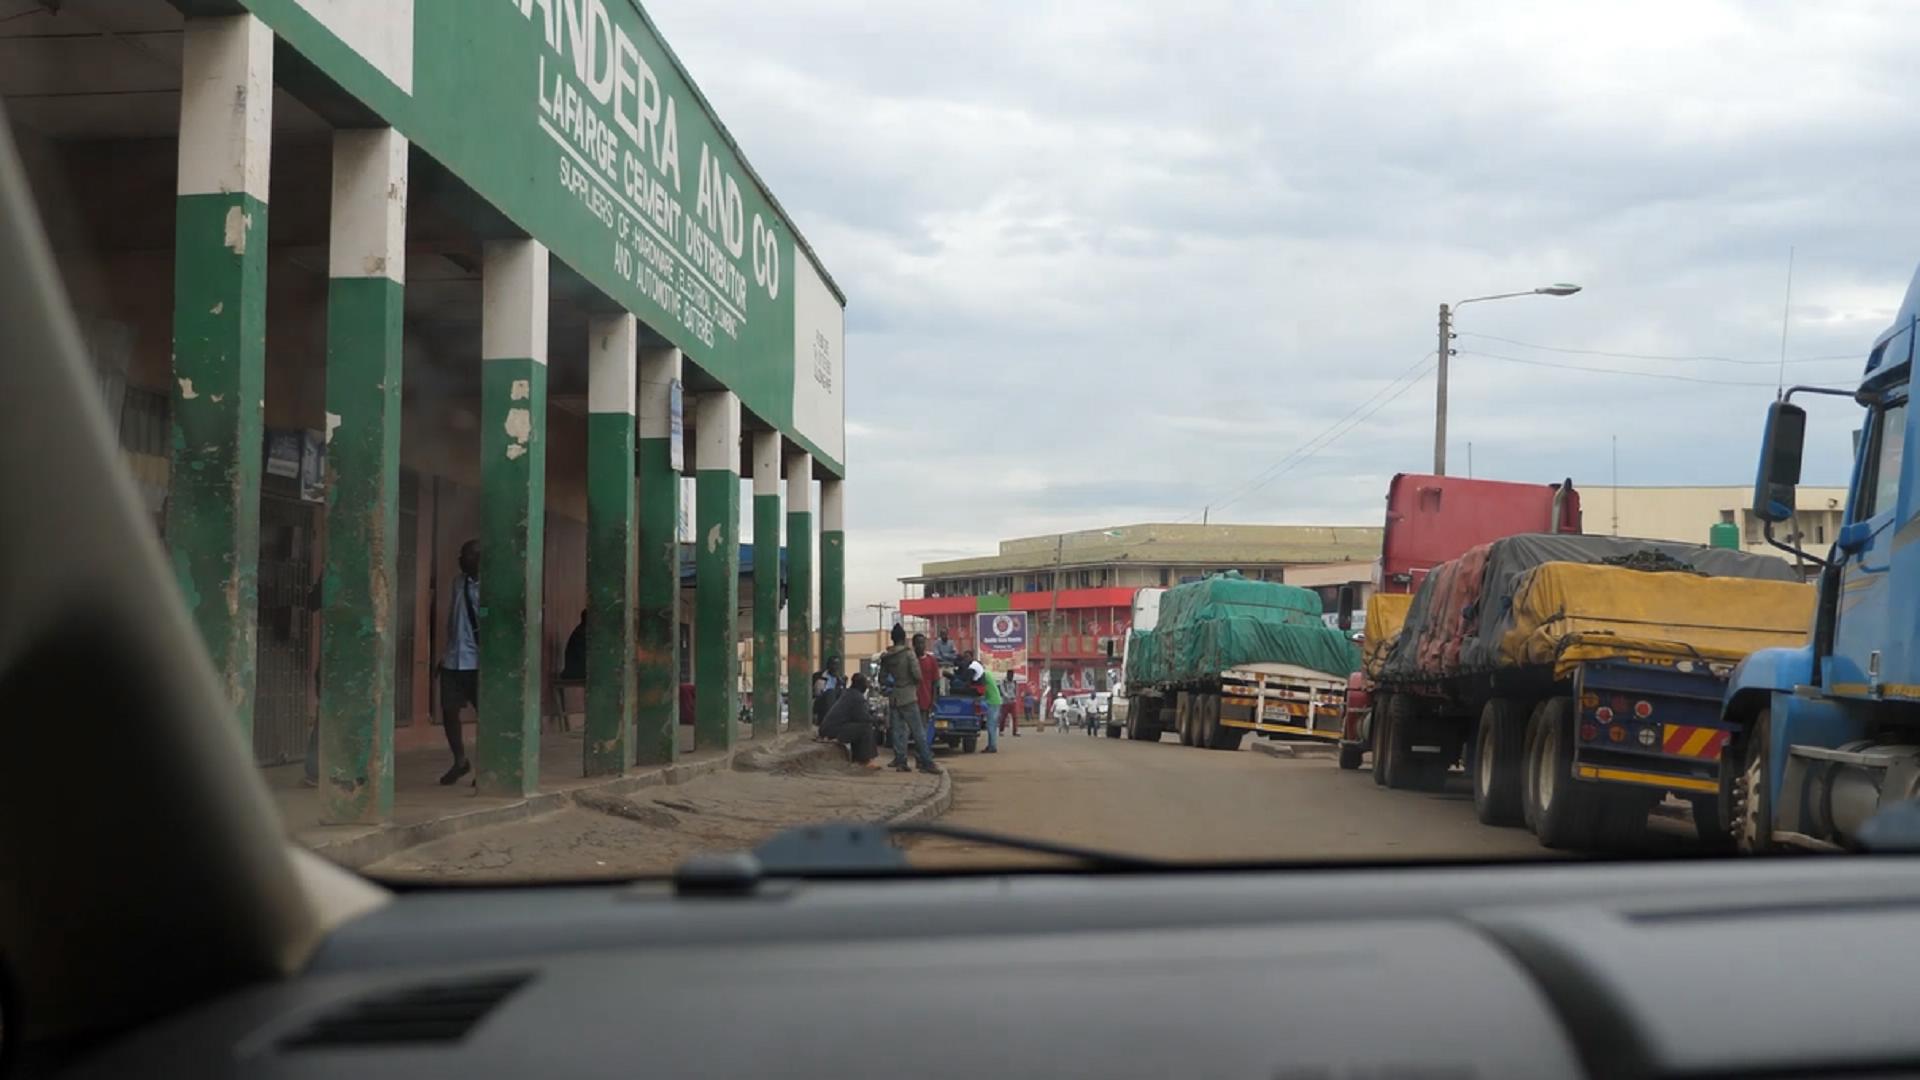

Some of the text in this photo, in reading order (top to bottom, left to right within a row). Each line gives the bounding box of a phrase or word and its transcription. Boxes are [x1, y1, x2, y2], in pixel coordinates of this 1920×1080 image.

[512, 0, 779, 300] NDERA AND CO
[539, 55, 747, 313] LAFARGE CEMENT DISTRIBUTOR
[560, 155, 614, 229] SUPPLIERS
[617, 212, 630, 241] OF
[614, 240, 632, 280] AND
